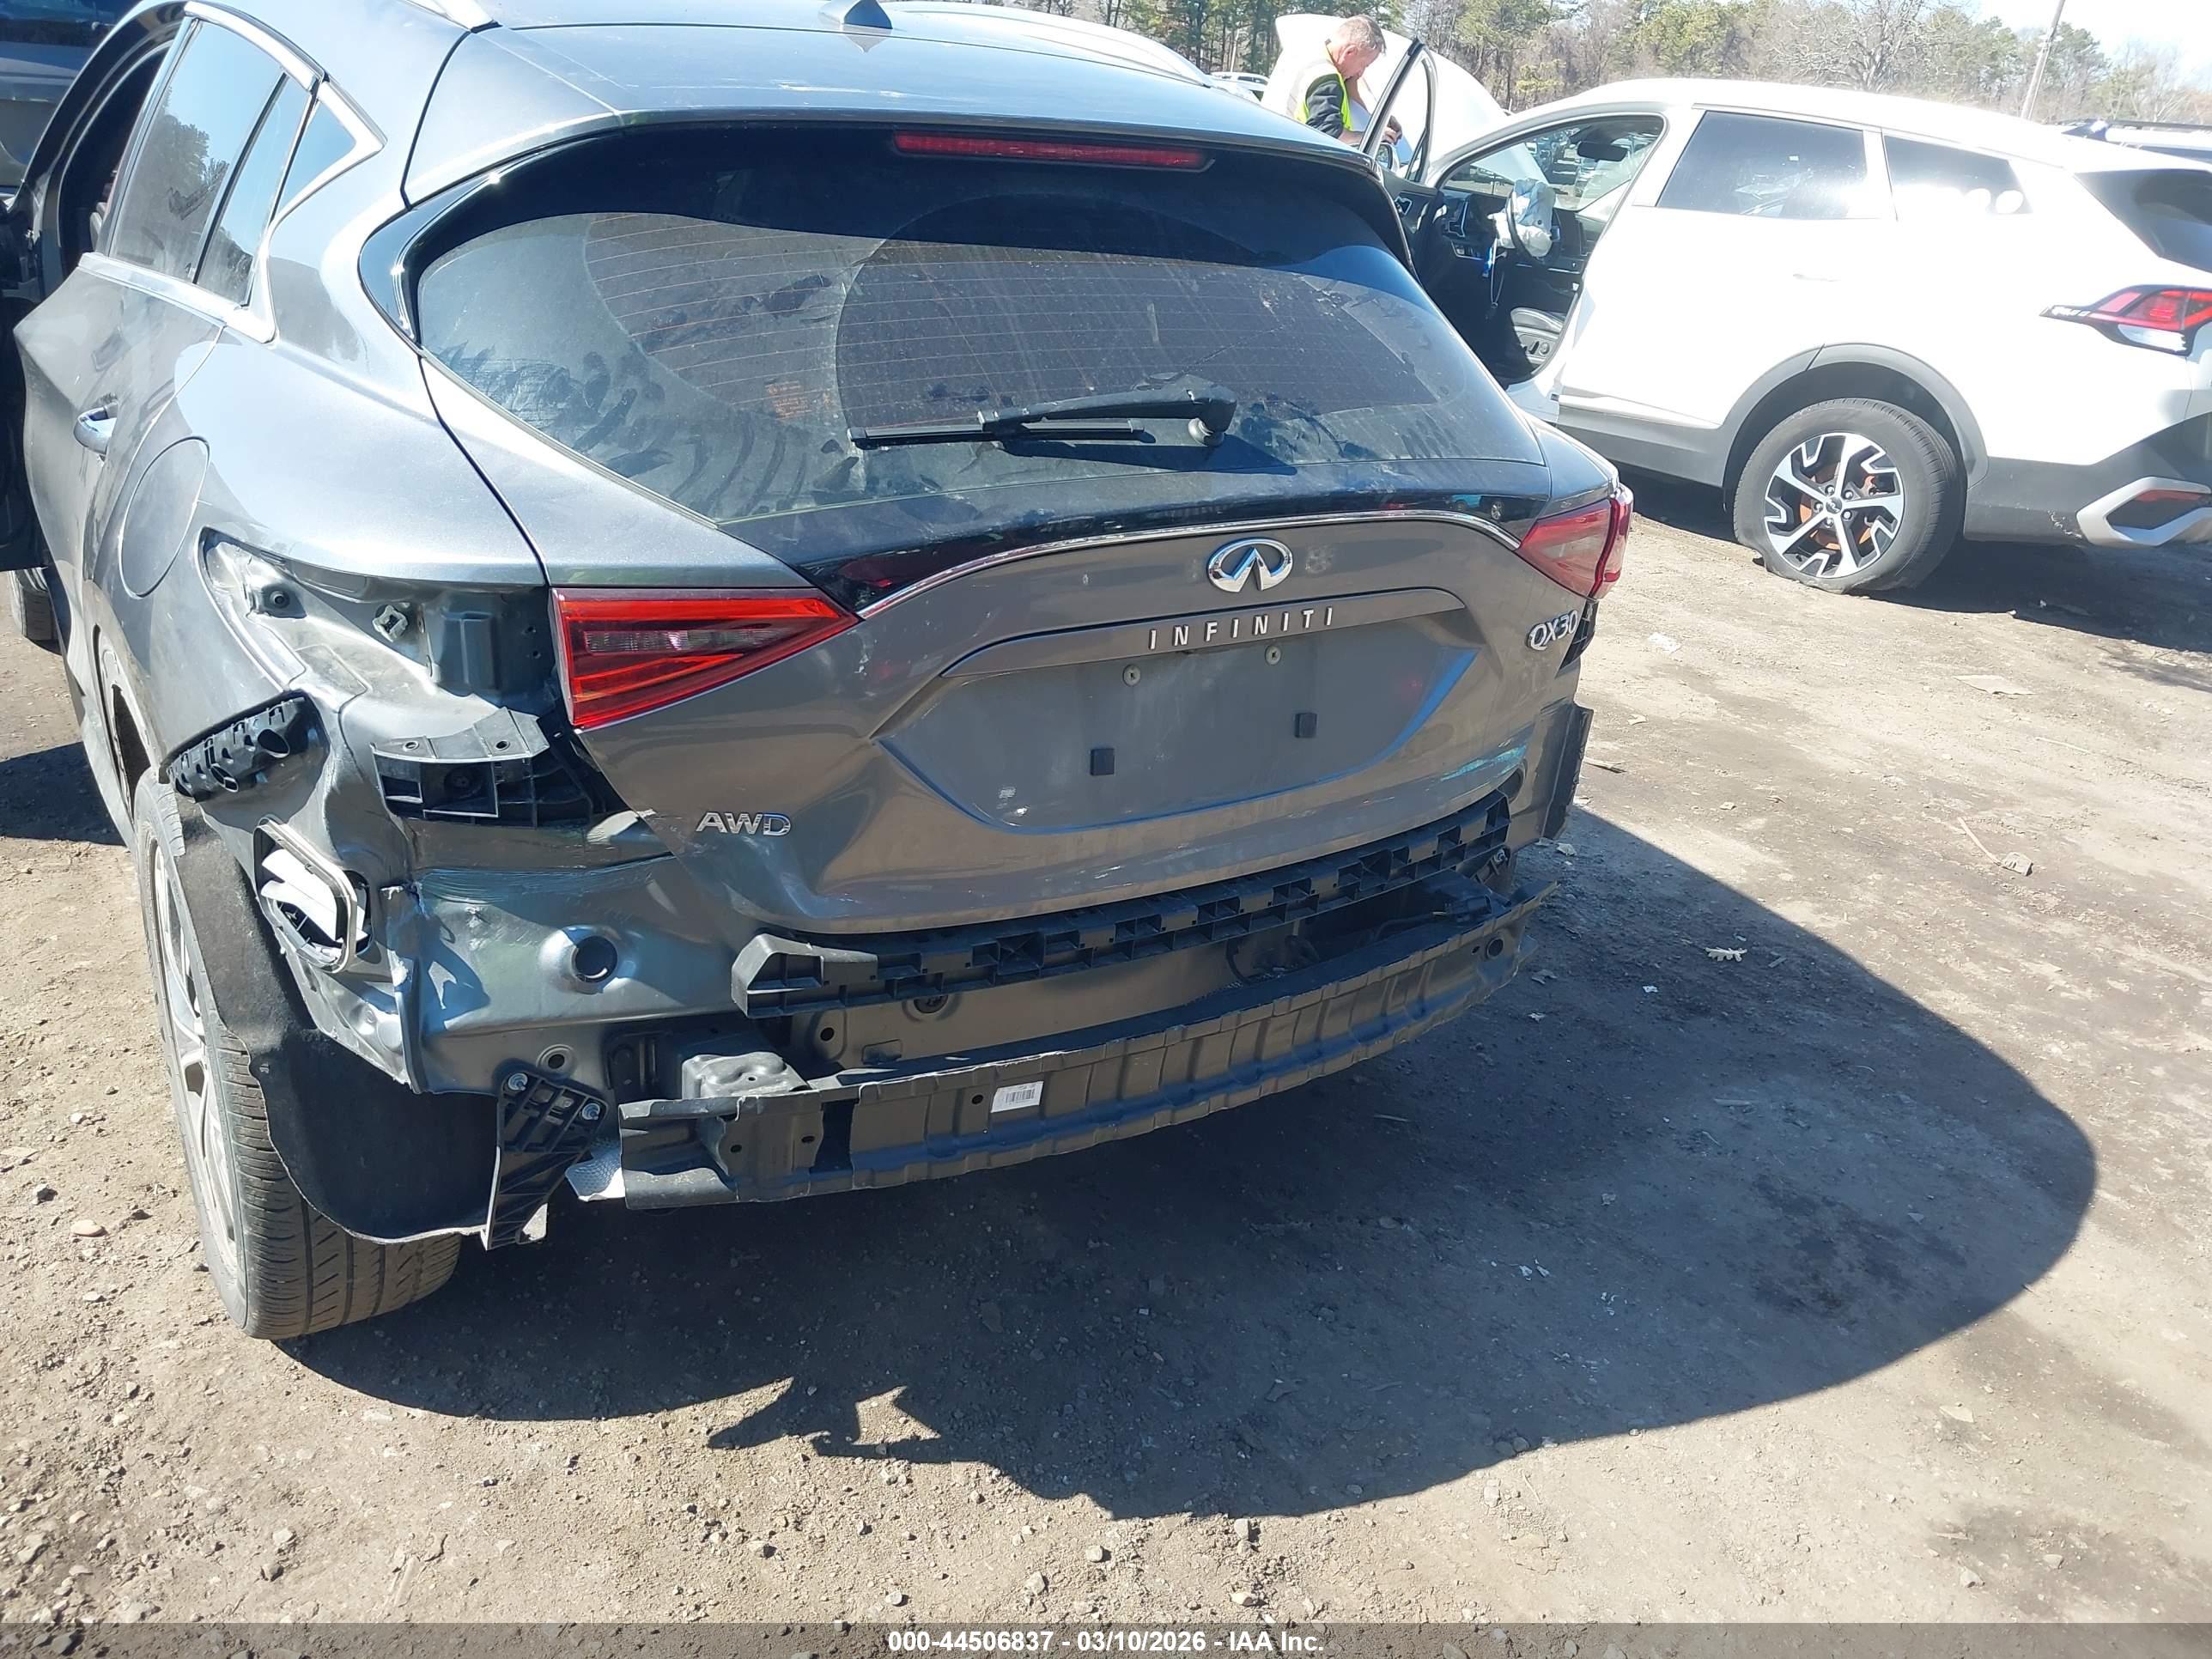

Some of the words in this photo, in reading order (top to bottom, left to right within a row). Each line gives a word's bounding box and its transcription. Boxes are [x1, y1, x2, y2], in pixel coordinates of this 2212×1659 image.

[1149, 606, 1334, 650] INFINITI
[1527, 610, 1578, 651] QX30
[696, 811, 792, 836] AWD
